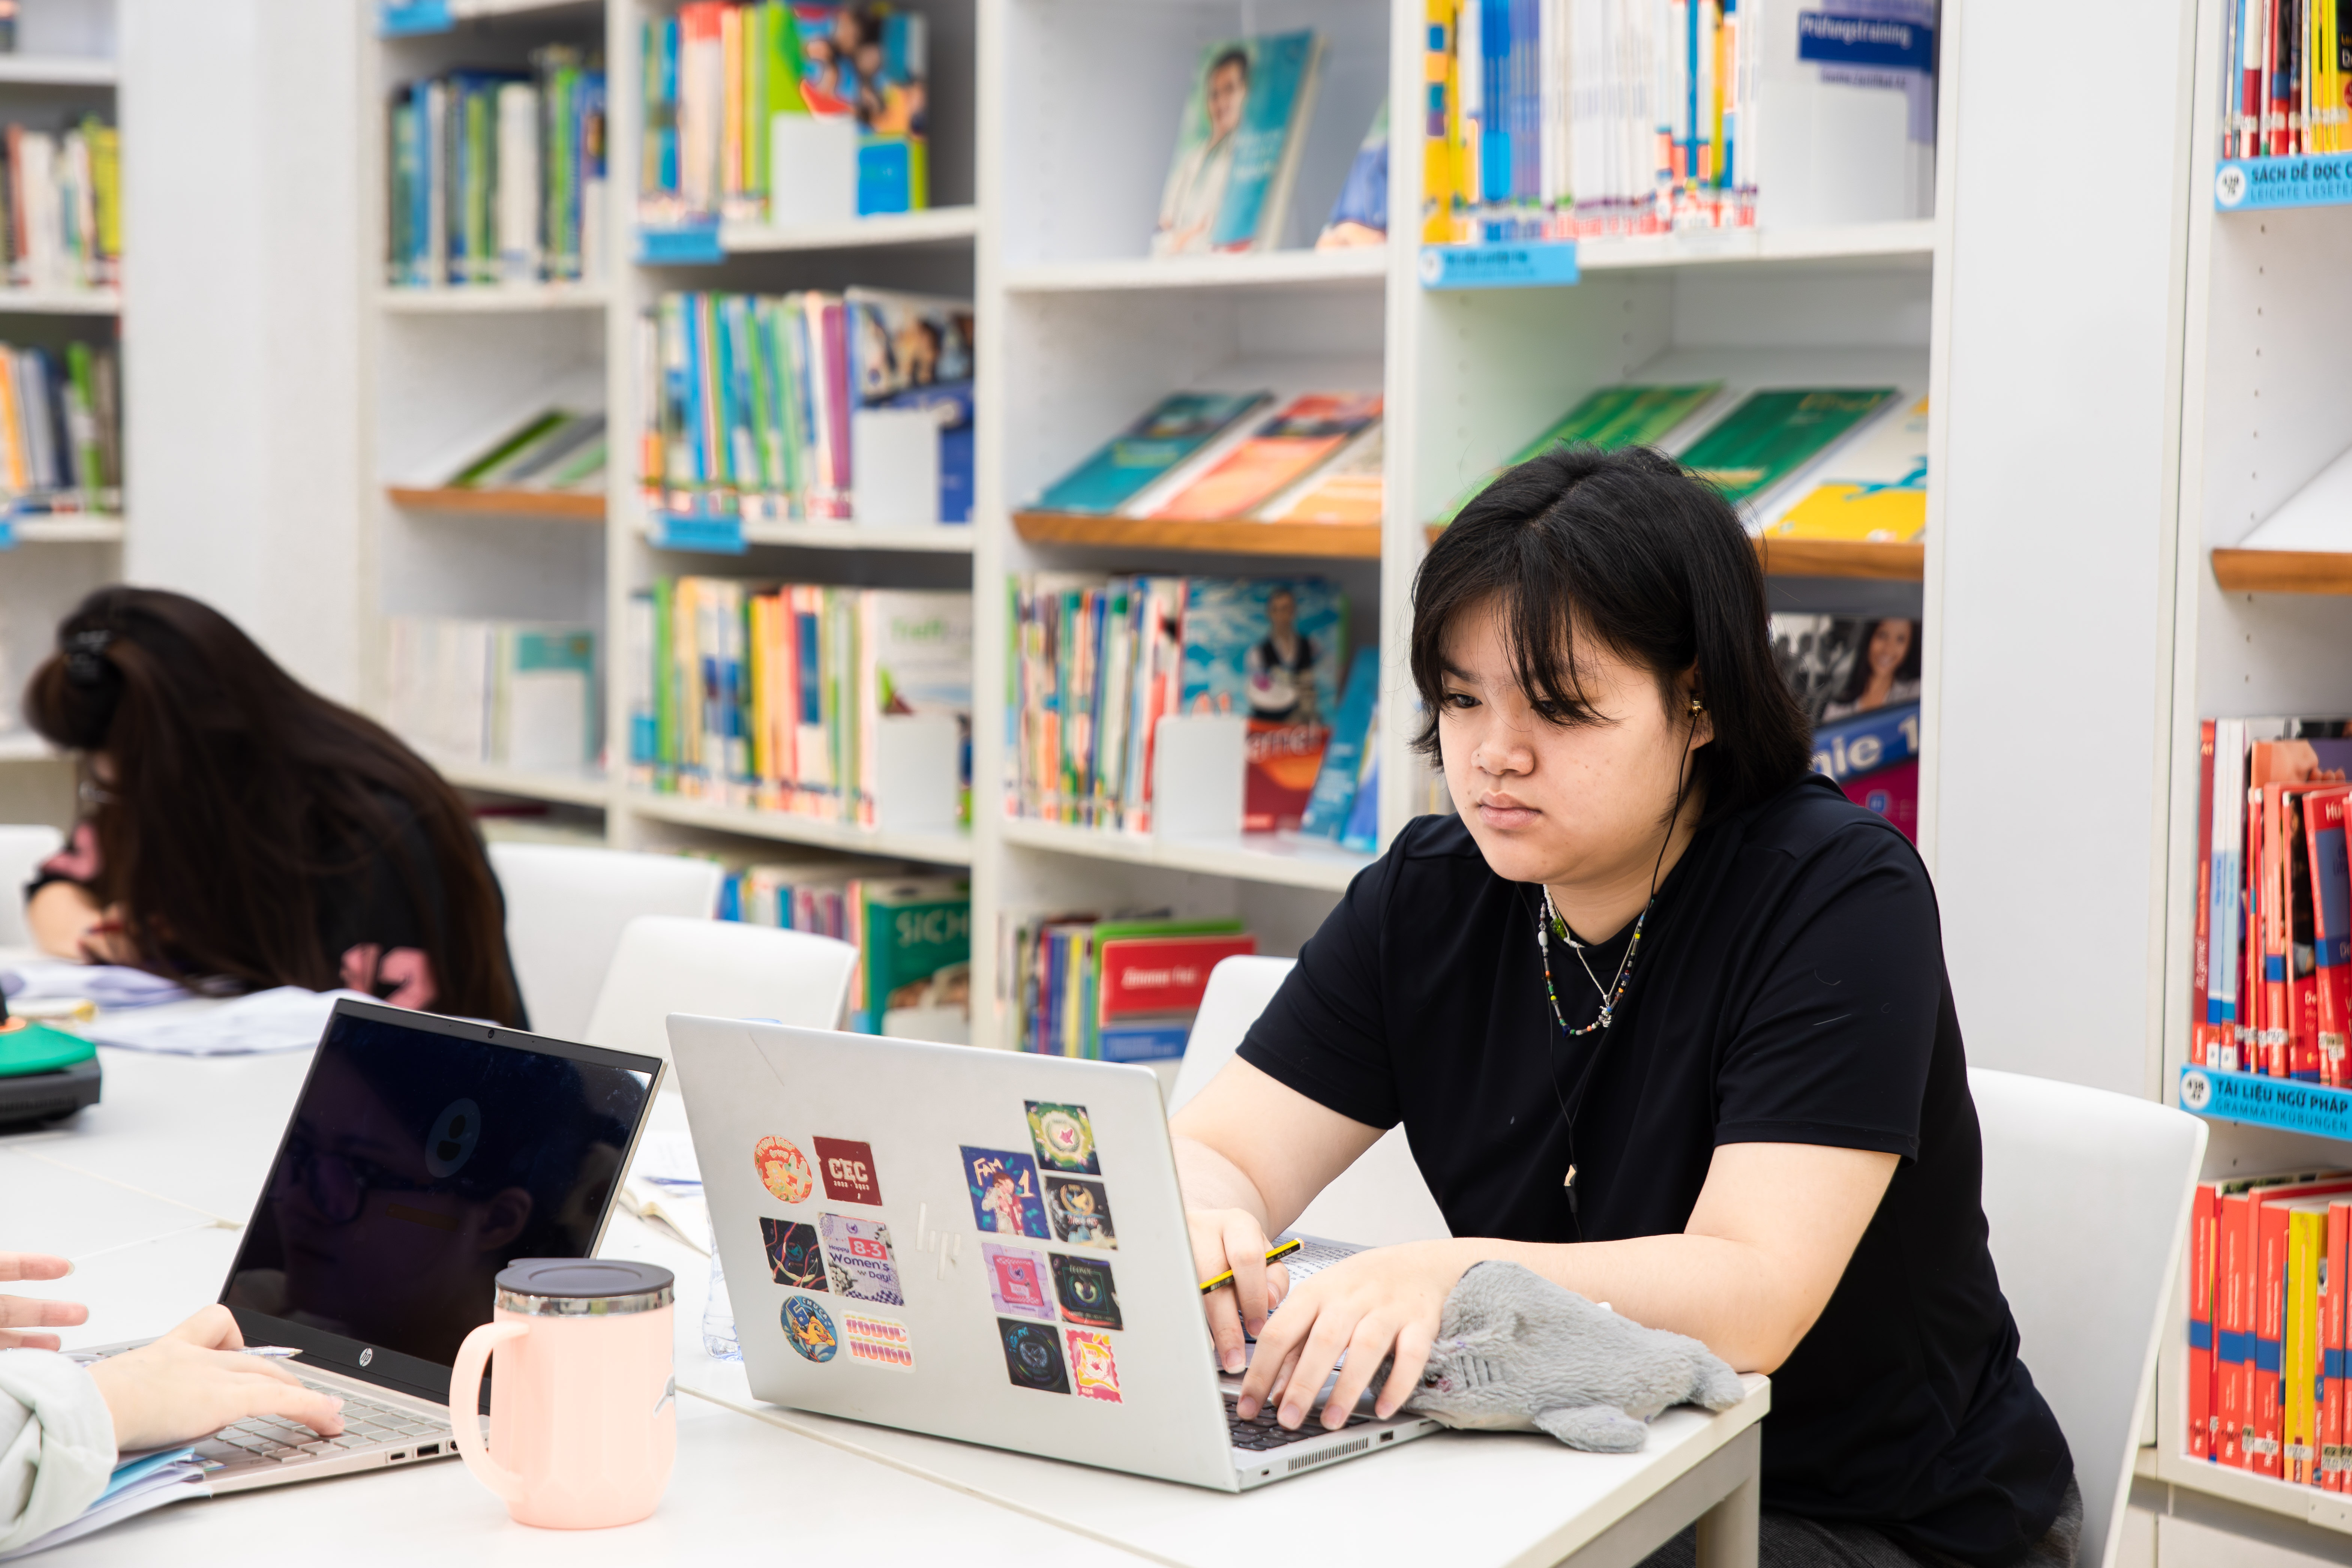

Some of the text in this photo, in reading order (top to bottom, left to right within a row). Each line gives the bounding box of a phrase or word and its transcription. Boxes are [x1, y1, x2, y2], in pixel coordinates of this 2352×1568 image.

[828, 1158, 868, 1182] CEC
[829, 1244, 849, 1253] Happy
[829, 1252, 890, 1271] Women's
[869, 1271, 891, 1283] Day!
[360, 1348, 372, 1367] hp
